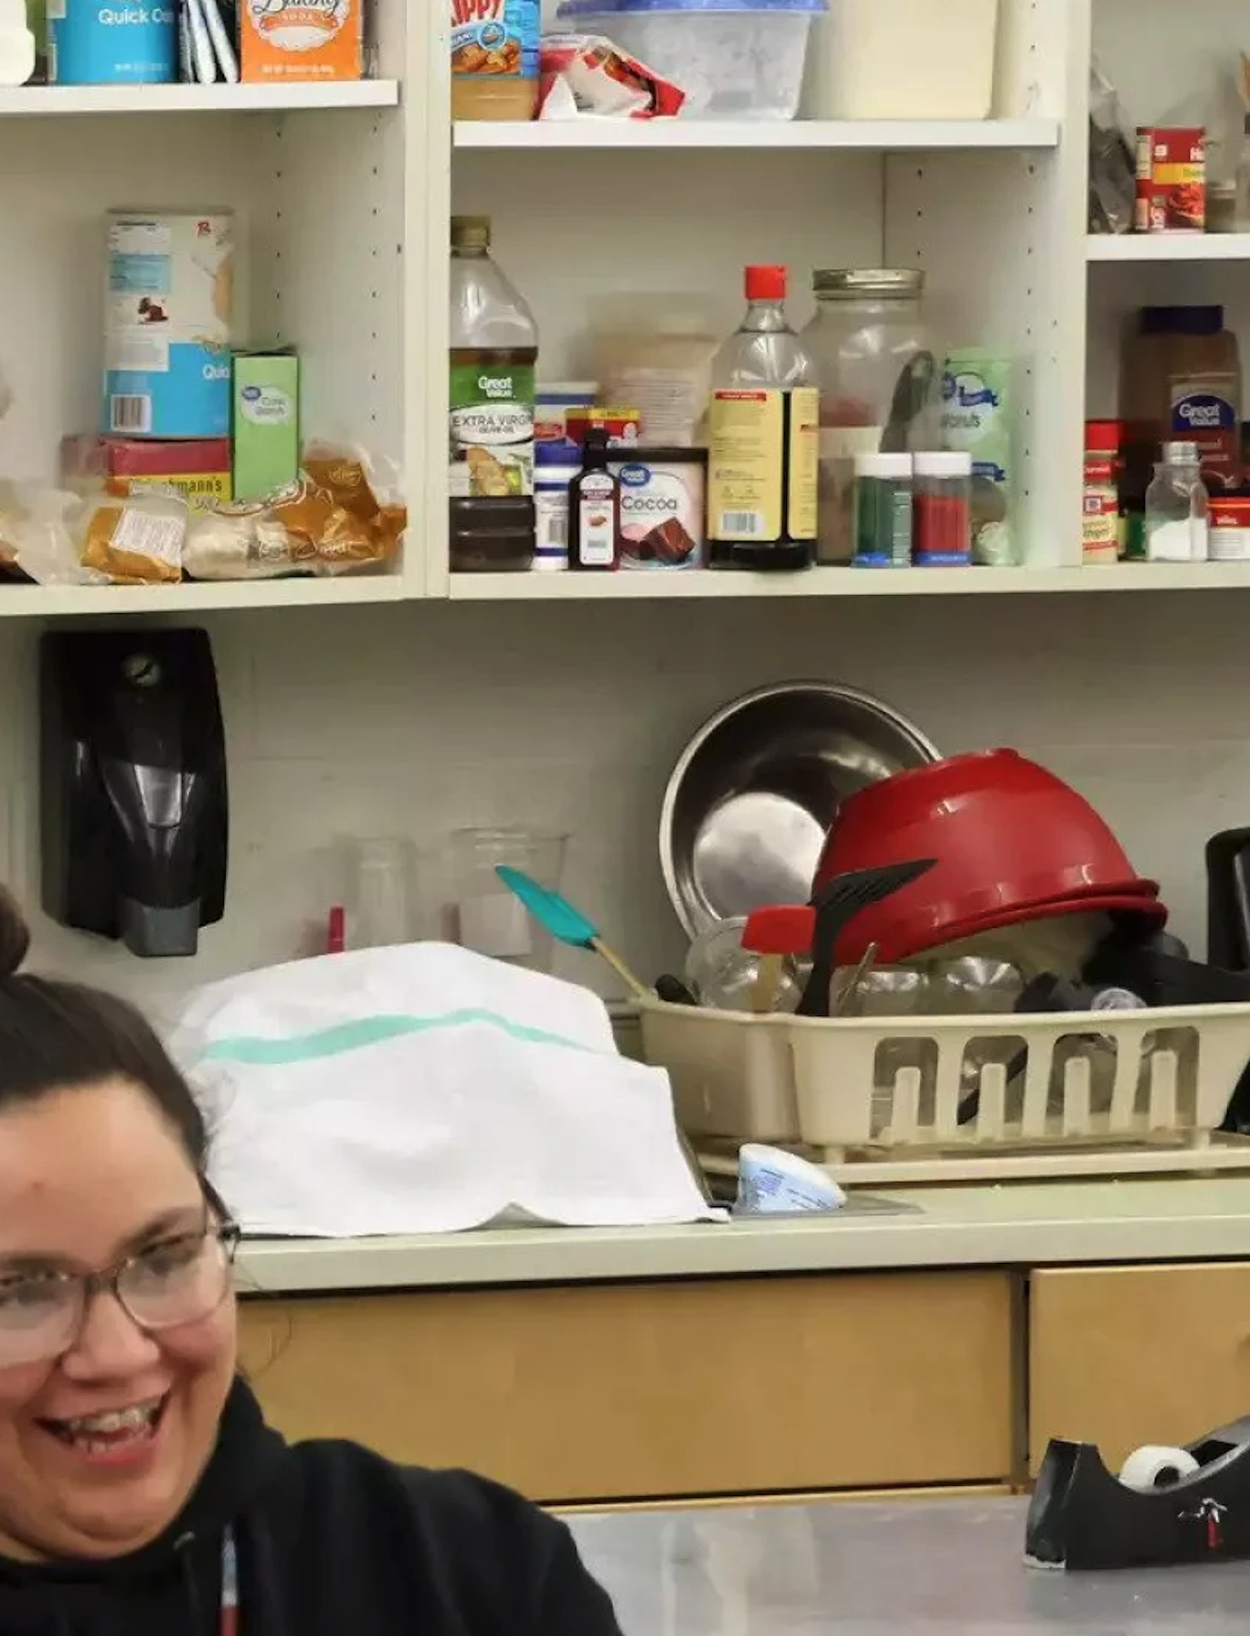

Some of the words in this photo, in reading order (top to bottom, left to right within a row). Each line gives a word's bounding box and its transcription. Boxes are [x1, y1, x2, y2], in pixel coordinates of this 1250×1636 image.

[97, 8, 149, 24] Quick
[478, 376, 513, 389] Great
[1179, 402, 1220, 418] Great
[452, 414, 495, 427] EXTRA
[621, 495, 677, 511] Cocoa
